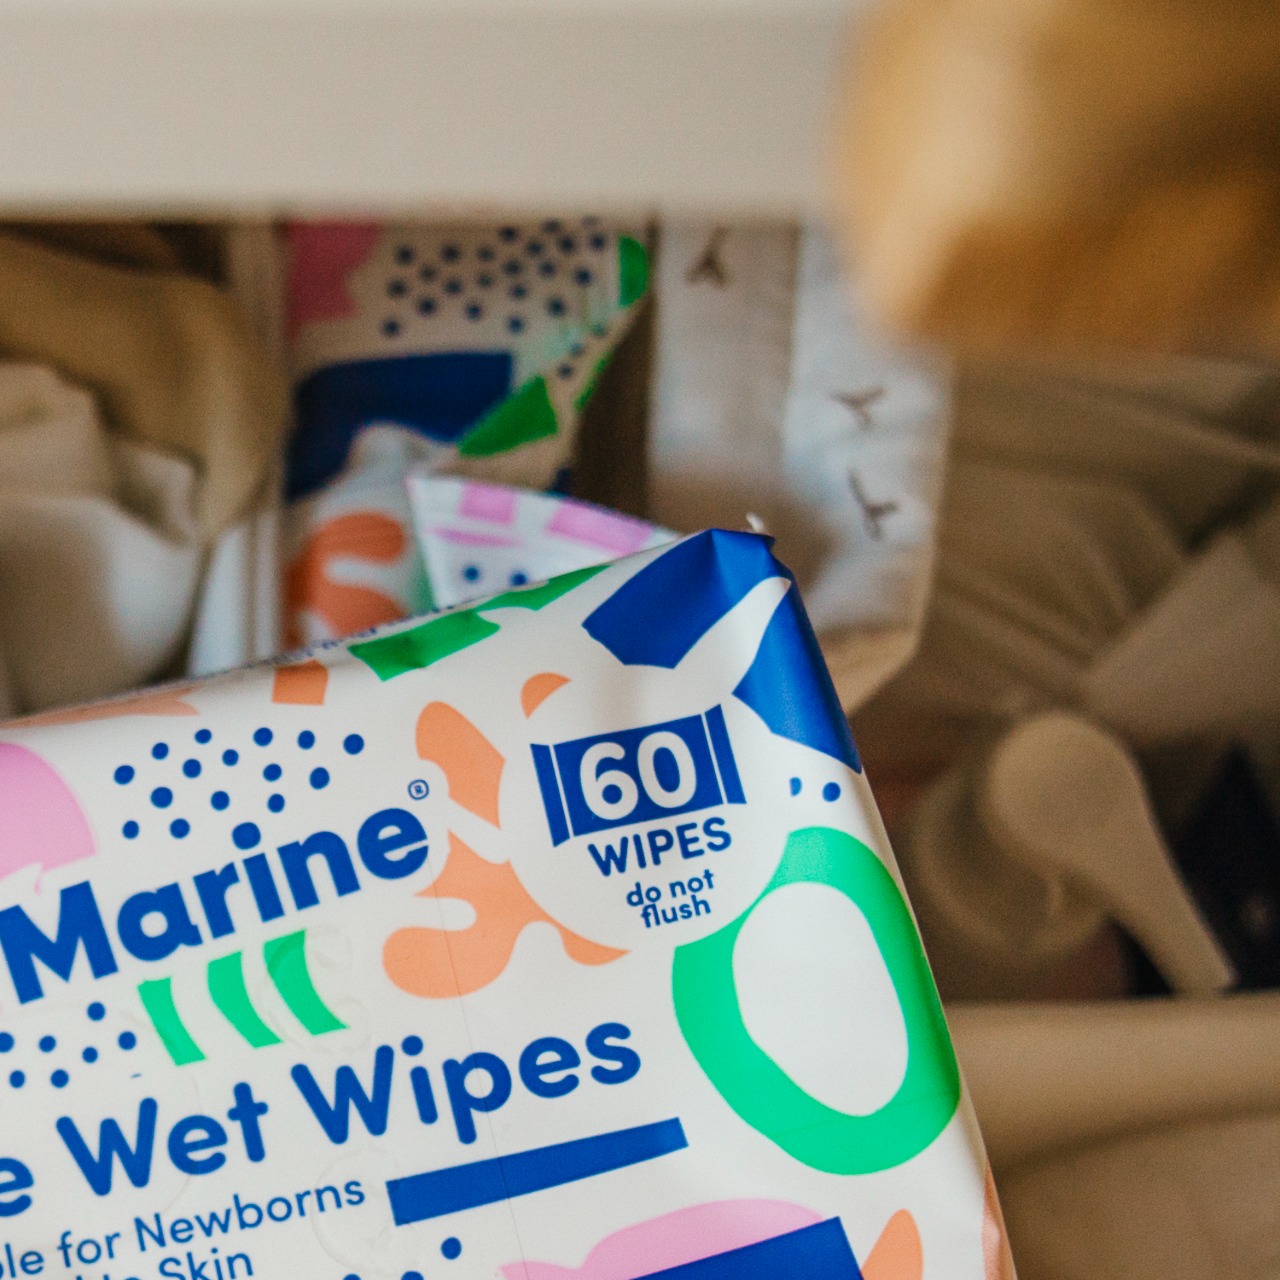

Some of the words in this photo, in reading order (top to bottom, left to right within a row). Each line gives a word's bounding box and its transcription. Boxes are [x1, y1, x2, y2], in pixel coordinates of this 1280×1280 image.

[578, 729, 700, 822] 60
[588, 816, 733, 878] WIPES
[625, 880, 664, 908] do
[669, 868, 716, 900] not
[640, 894, 712, 929] flush
[56, 1082, 269, 1198] Wet
[290, 1021, 642, 1146] Wipes
[57, 1227, 123, 1267] for
[133, 1179, 366, 1254] Newborns
